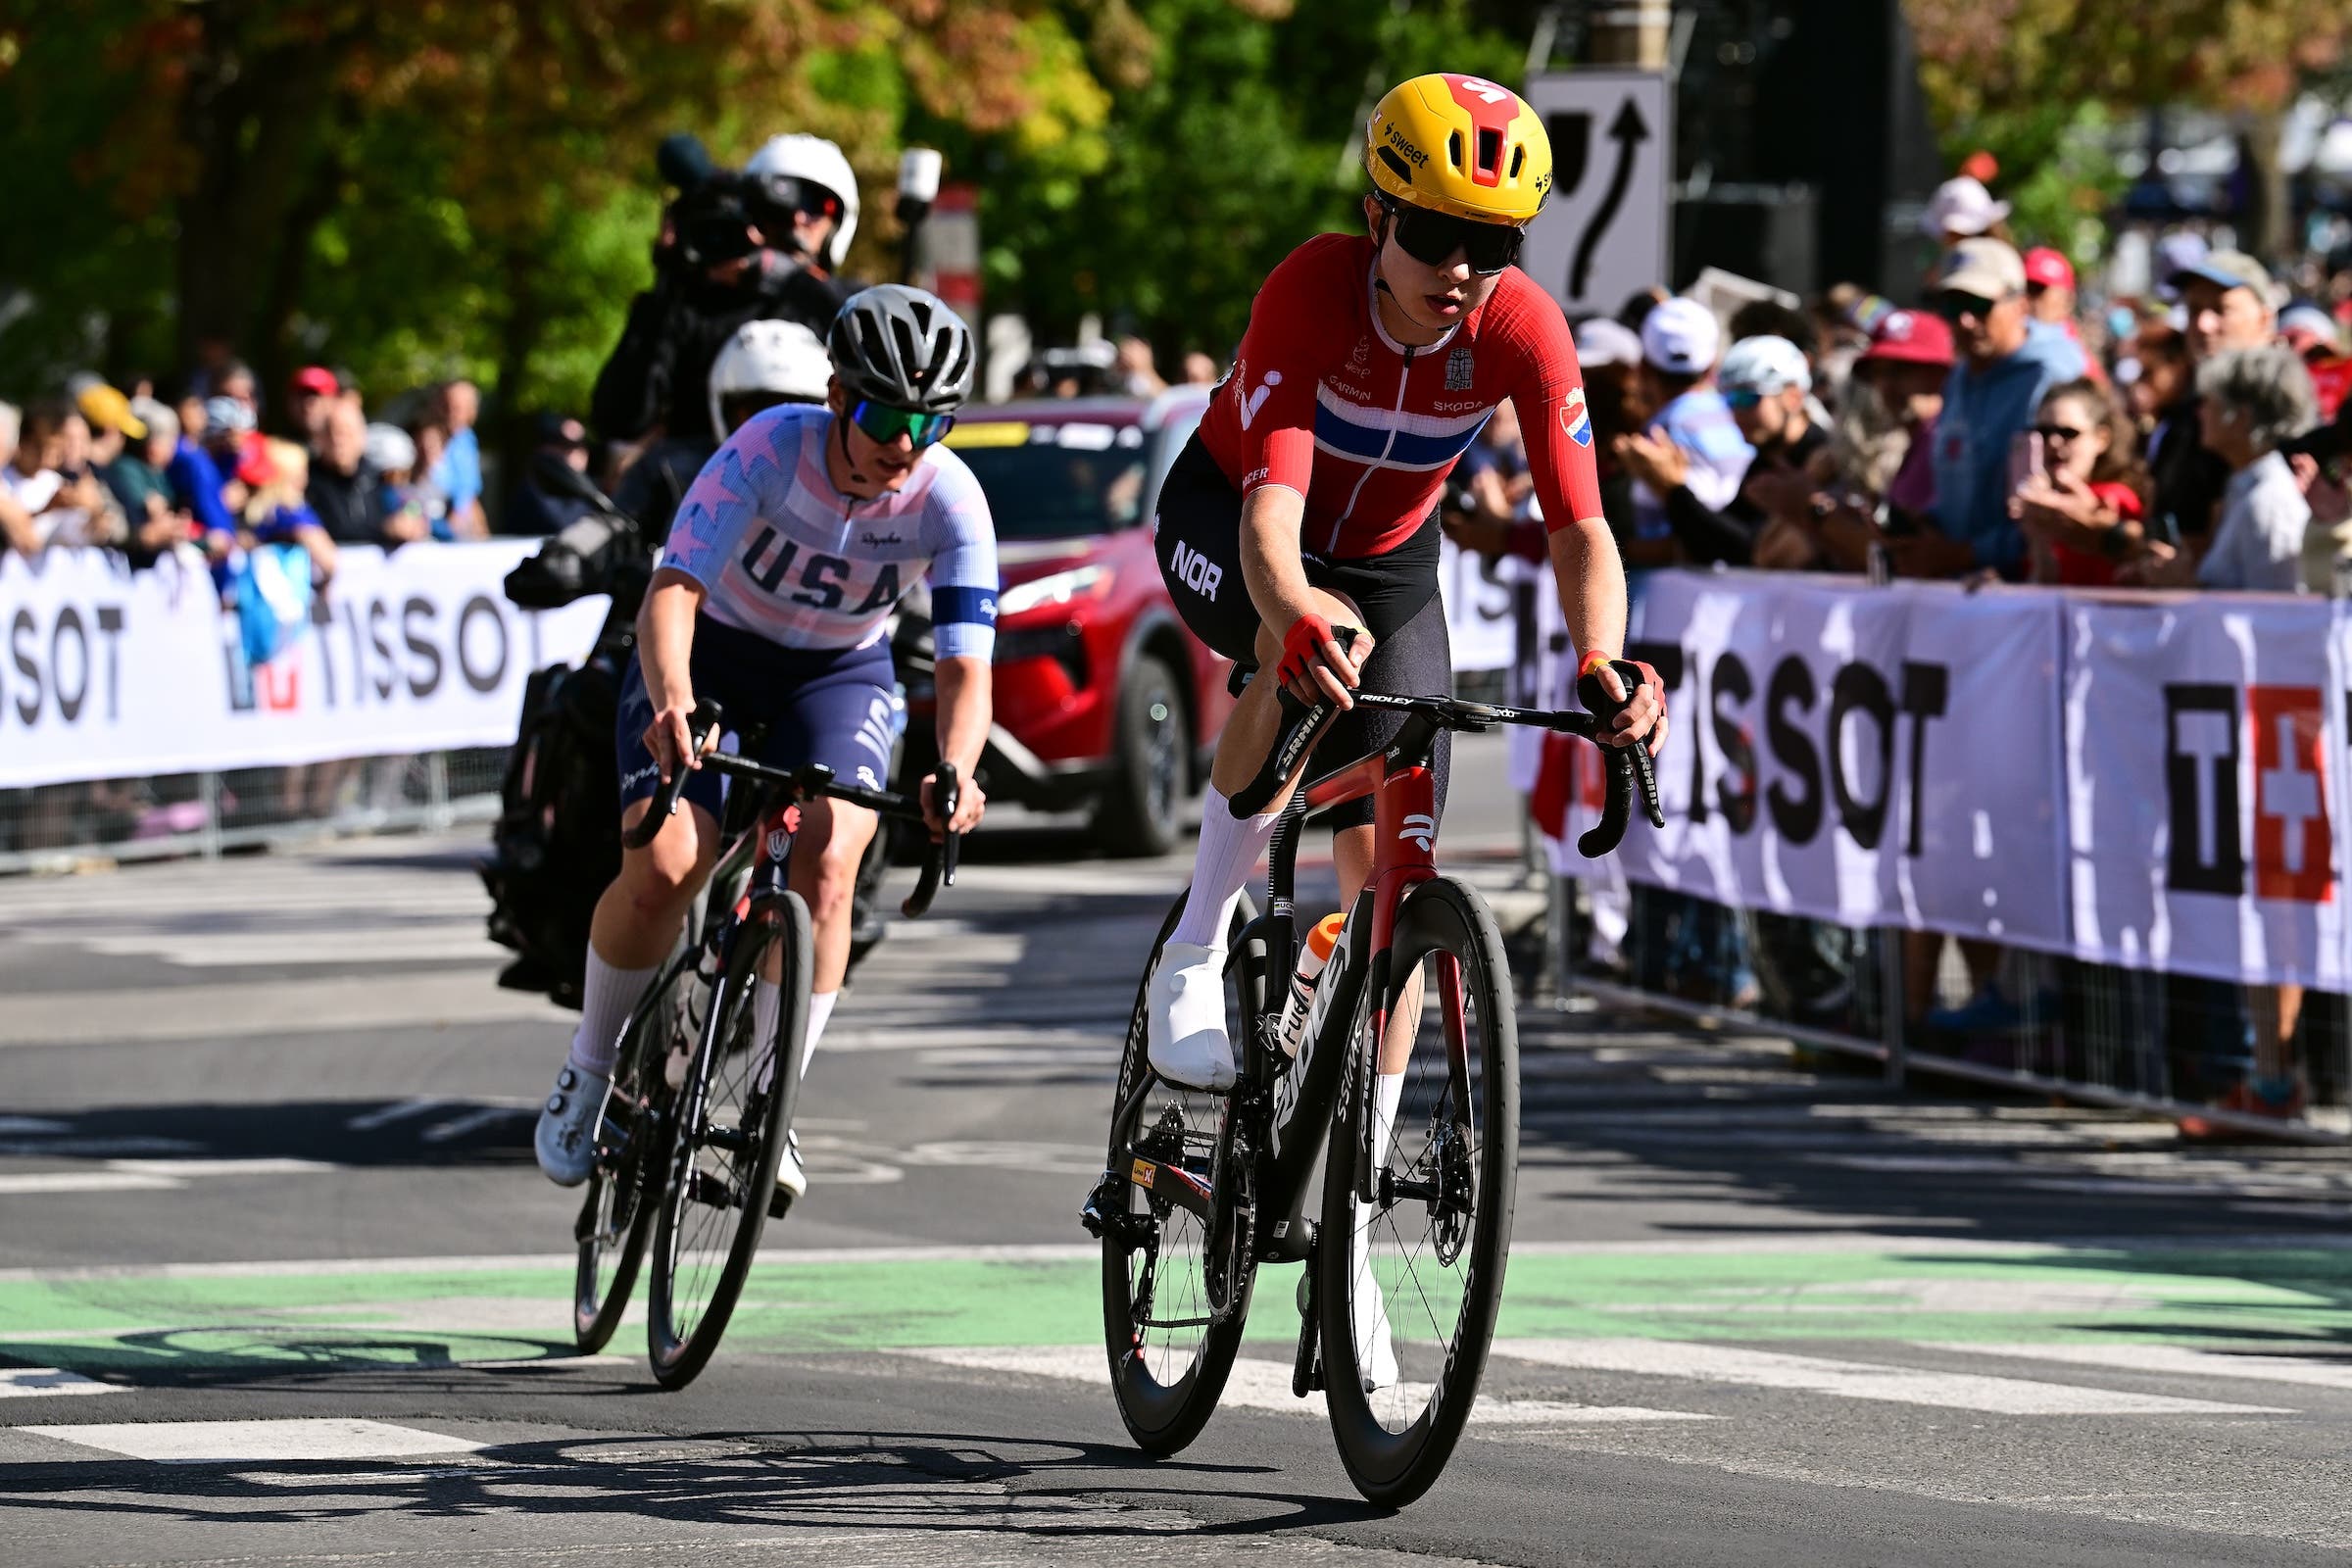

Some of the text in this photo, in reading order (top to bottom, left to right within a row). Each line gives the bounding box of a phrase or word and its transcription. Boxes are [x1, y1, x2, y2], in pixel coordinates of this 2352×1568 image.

[1390, 131, 1431, 170] sweet
[1329, 374, 1372, 401] GARMIN
[742, 526, 900, 615] USA
[1170, 539, 1223, 603] NOR
[1359, 694, 1414, 706] RIDLEY
[1627, 643, 1948, 859] TISSOT
[1119, 1011, 1144, 1102] SWISS
[1271, 892, 1362, 1159] RIDLEY
[1338, 1018, 1363, 1124] SWISS
